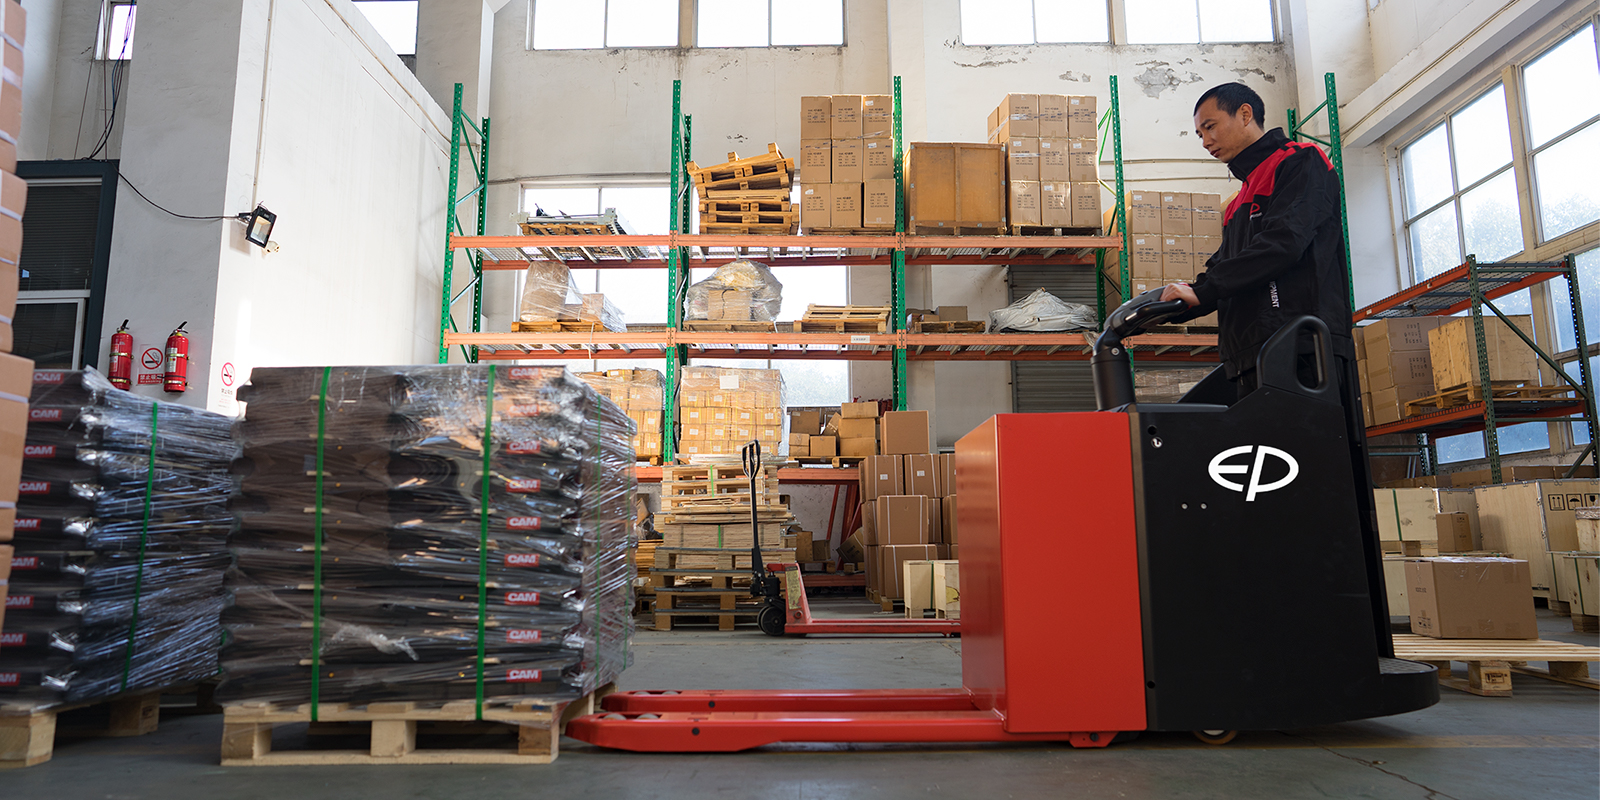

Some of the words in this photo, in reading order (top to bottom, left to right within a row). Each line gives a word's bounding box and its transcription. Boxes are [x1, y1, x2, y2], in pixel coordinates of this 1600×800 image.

[34, 373, 61, 382] CAM
[31, 410, 59, 418] CAM
[24, 446, 53, 454] CAM
[509, 442, 537, 450] CAM
[1208, 445, 1299, 501] EP
[19, 482, 47, 491] CAM
[509, 480, 537, 489] CAM
[509, 518, 537, 526] CAM
[507, 555, 536, 563] CAM
[508, 593, 536, 602] CAM
[509, 630, 538, 639] CAM
[0, 673, 17, 682] AM
[509, 670, 539, 679] CAM
